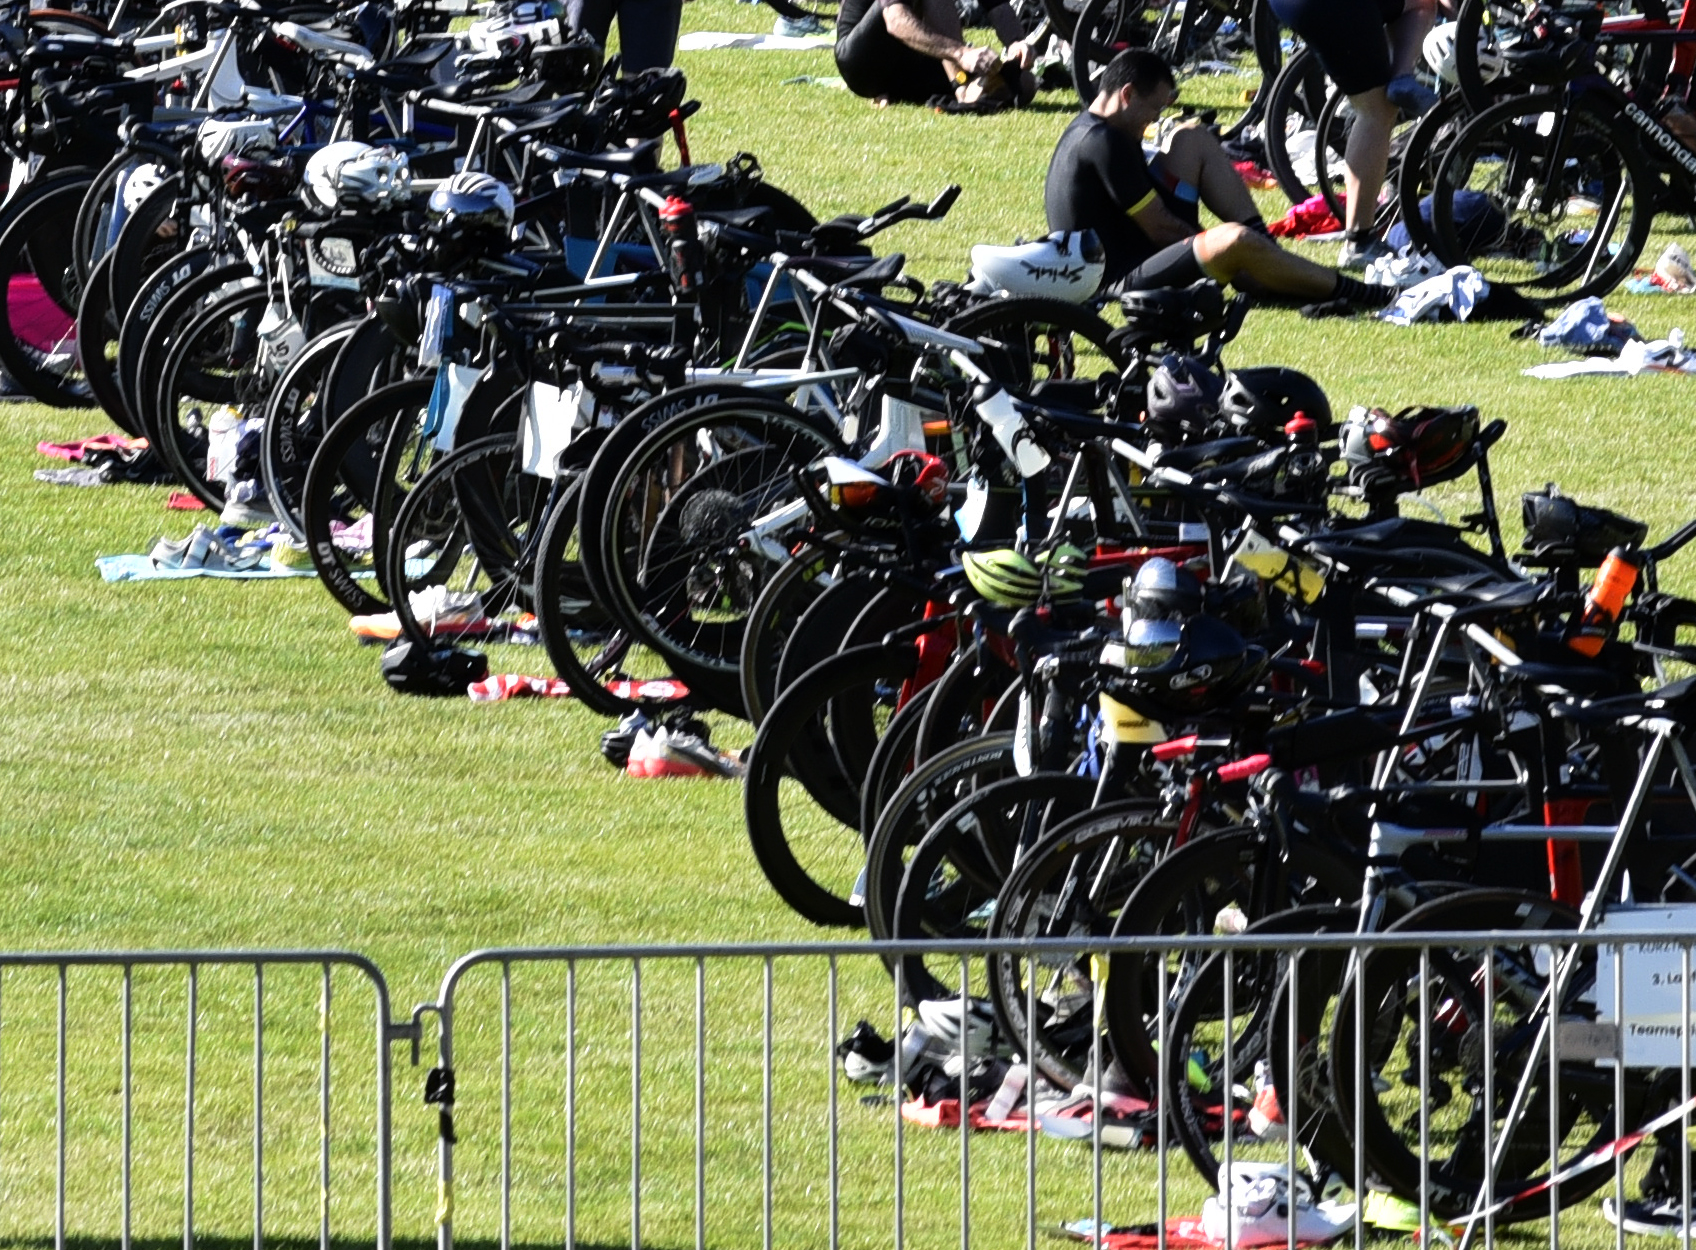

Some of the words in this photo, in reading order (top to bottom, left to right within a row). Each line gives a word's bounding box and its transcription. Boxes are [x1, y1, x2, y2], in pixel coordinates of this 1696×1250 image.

[317, 542, 335, 567] DT
[329, 568, 366, 608] SWISS
[1667, 969, 1696, 985] Laf
